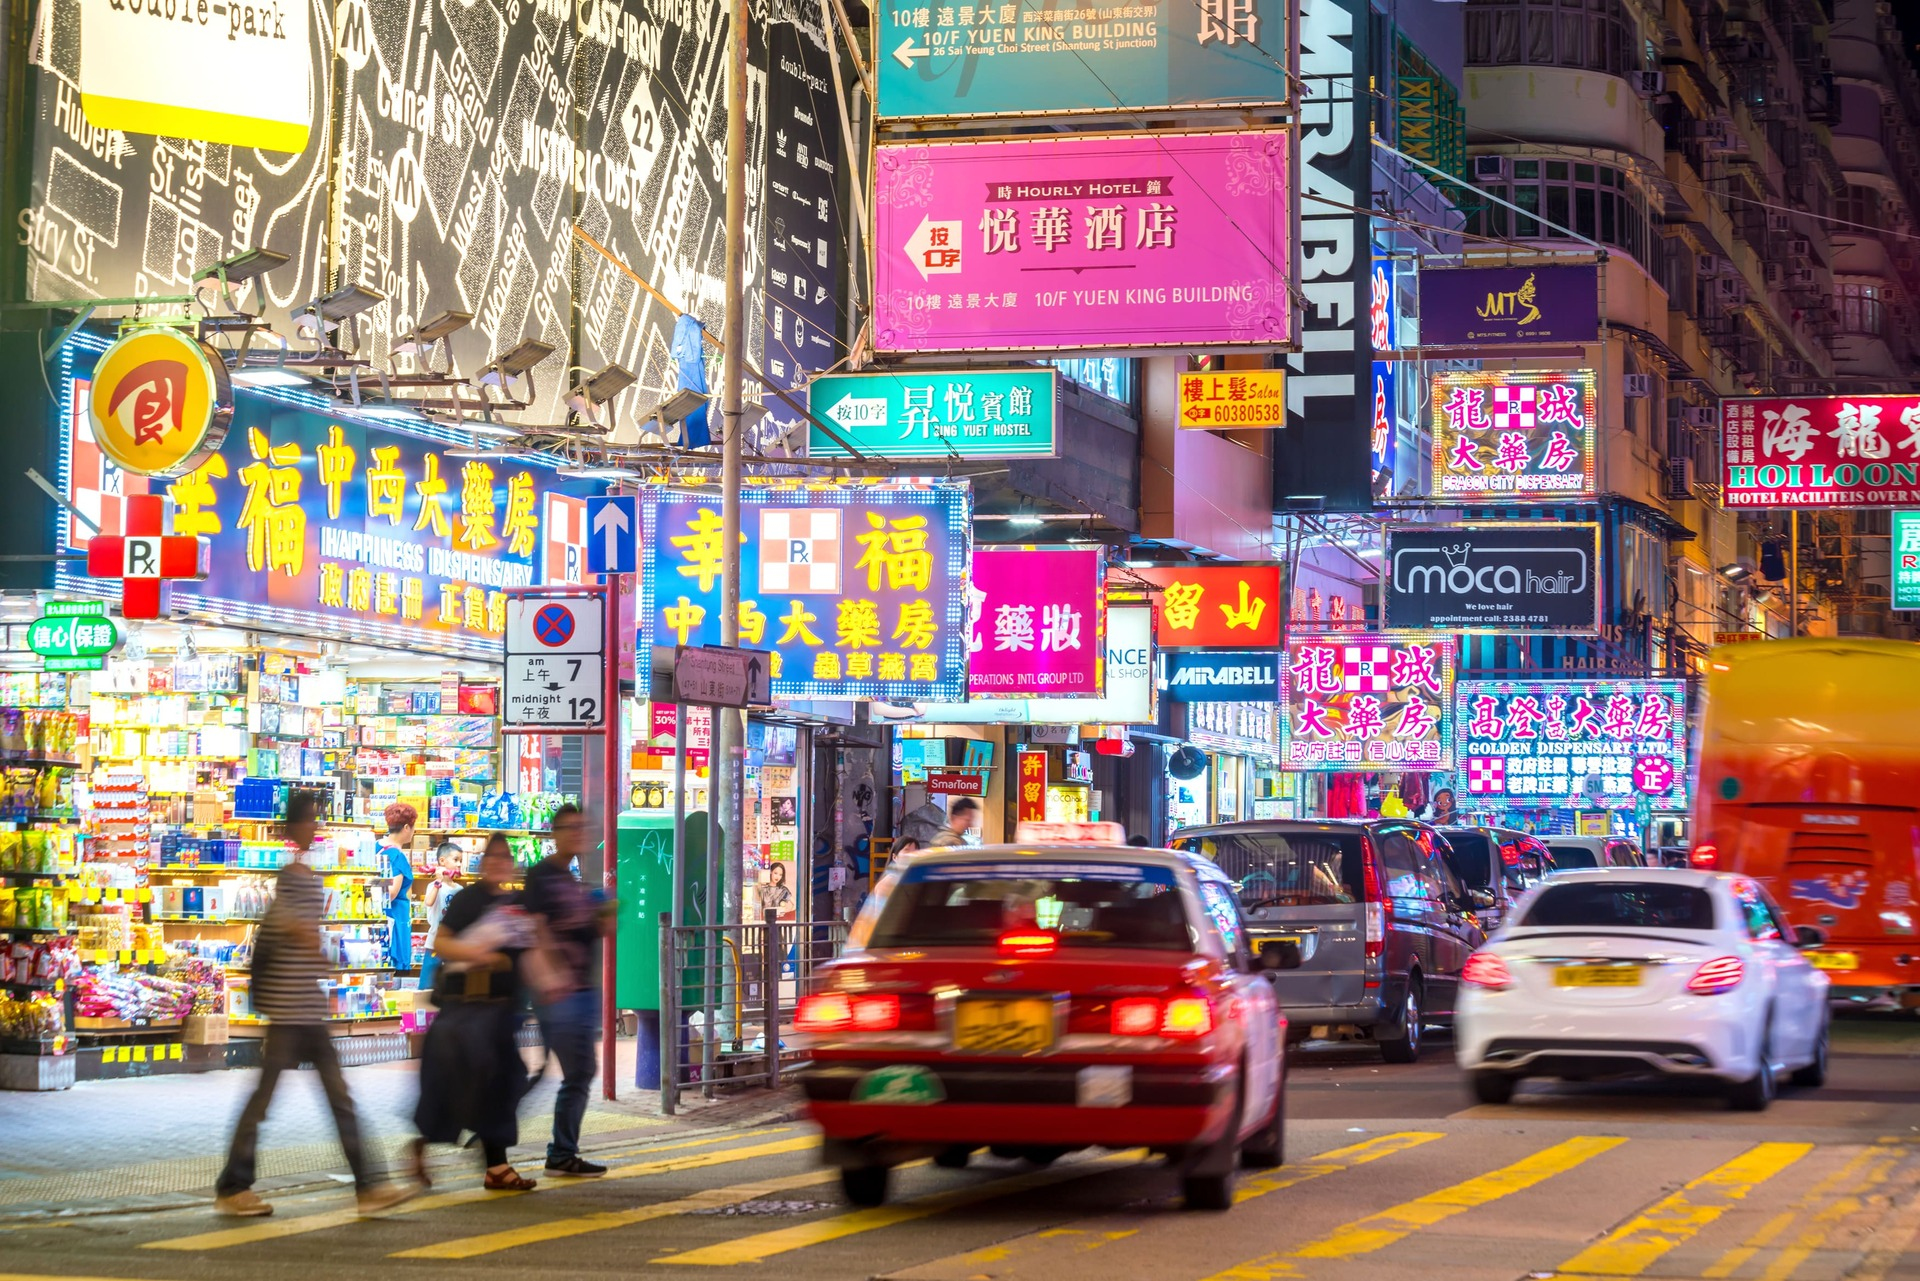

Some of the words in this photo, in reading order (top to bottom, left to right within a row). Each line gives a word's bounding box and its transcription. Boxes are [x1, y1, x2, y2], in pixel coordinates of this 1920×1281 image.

[892, 8, 931, 28] 10樓
[936, 4, 1017, 27] 遠景大廈
[922, 29, 961, 47] 10/F
[966, 26, 1016, 45] YUEN
[1024, 23, 1065, 43] KING
[1072, 21, 1158, 40] BUILDING
[933, 46, 946, 57] 26
[947, 45, 963, 56] Sai
[965, 43, 995, 57] Yeung
[997, 43, 1018, 54] Choi
[1020, 41, 1051, 54] Street
[1052, 39, 1101, 53] (Shantung
[1103, 39, 1115, 50] St
[1115, 38, 1157, 51] junction)
[531, 34, 571, 125] Street
[780, 54, 828, 95] double-park
[450, 46, 494, 147] Grand
[793, 105, 814, 127] Brands
[631, 103, 655, 153] 22
[796, 152, 809, 168] HERO
[797, 142, 808, 156] ANTI
[150, 144, 177, 203] St.
[997, 185, 1013, 201] 時
[1016, 186, 1082, 197] HOURLY
[1088, 183, 1143, 195] HOTEL
[450, 169, 484, 260] West
[929, 226, 949, 247] 按
[71, 224, 99, 285] St.
[479, 206, 527, 345] Wooster
[533, 216, 577, 328] Greene
[905, 293, 941, 310] 10樓
[947, 291, 1018, 309] 遠景大廈
[1034, 292, 1068, 307] 10/F
[1073, 290, 1118, 305] YUEN
[1126, 288, 1166, 304] KING
[1172, 285, 1254, 303] BUILDING
[1183, 377, 1248, 403] 樓上髮
[1247, 382, 1280, 400] Salon
[836, 403, 886, 421] 按10字
[1214, 403, 1281, 422] 60380538
[1442, 388, 1490, 431] 龍
[1538, 384, 1584, 430] 城
[963, 423, 988, 437] YUET
[993, 422, 1031, 437] HOSTEL
[1450, 432, 1578, 472] 大藥房
[1442, 474, 1488, 491] DRAGON
[1489, 475, 1516, 490] CITY
[1517, 473, 1584, 490] DISPENSARY
[1728, 464, 1803, 488] HOI
[1728, 493, 1780, 504] HOTEL
[1867, 490, 1908, 502] OVER
[854, 511, 935, 593] 福
[1408, 565, 1521, 594] moca
[1525, 569, 1575, 594] hair
[1465, 603, 1477, 611] We
[1478, 603, 1495, 611] love
[1496, 603, 1514, 611] hair
[1430, 615, 1483, 623] appointment
[1484, 614, 1501, 623] call:
[1502, 615, 1526, 623] 2388
[1527, 615, 1549, 623] 4781
[527, 657, 545, 666] am
[566, 659, 582, 682] 7
[1290, 646, 1343, 692] 龍
[1392, 645, 1441, 693] 城
[1562, 655, 1607, 671] HAIR
[522, 668, 551, 682] 上午
[1017, 675, 1036, 685] INTL
[1037, 673, 1068, 685] GROUP
[1068, 672, 1084, 684] LTD
[1118, 667, 1149, 679] SHOP
[511, 694, 562, 708] midnight
[568, 697, 596, 721] 12
[522, 706, 551, 720] 午夜
[654, 715, 677, 725] 30%
[1294, 695, 1436, 741] 大藥房
[1368, 740, 1442, 762] 信心保證
[1468, 742, 1532, 754] GOLDEN
[1536, 741, 1634, 755] DISPENSARY
[1636, 741, 1673, 755] LTD.
[1640, 771, 1664, 790] 正
